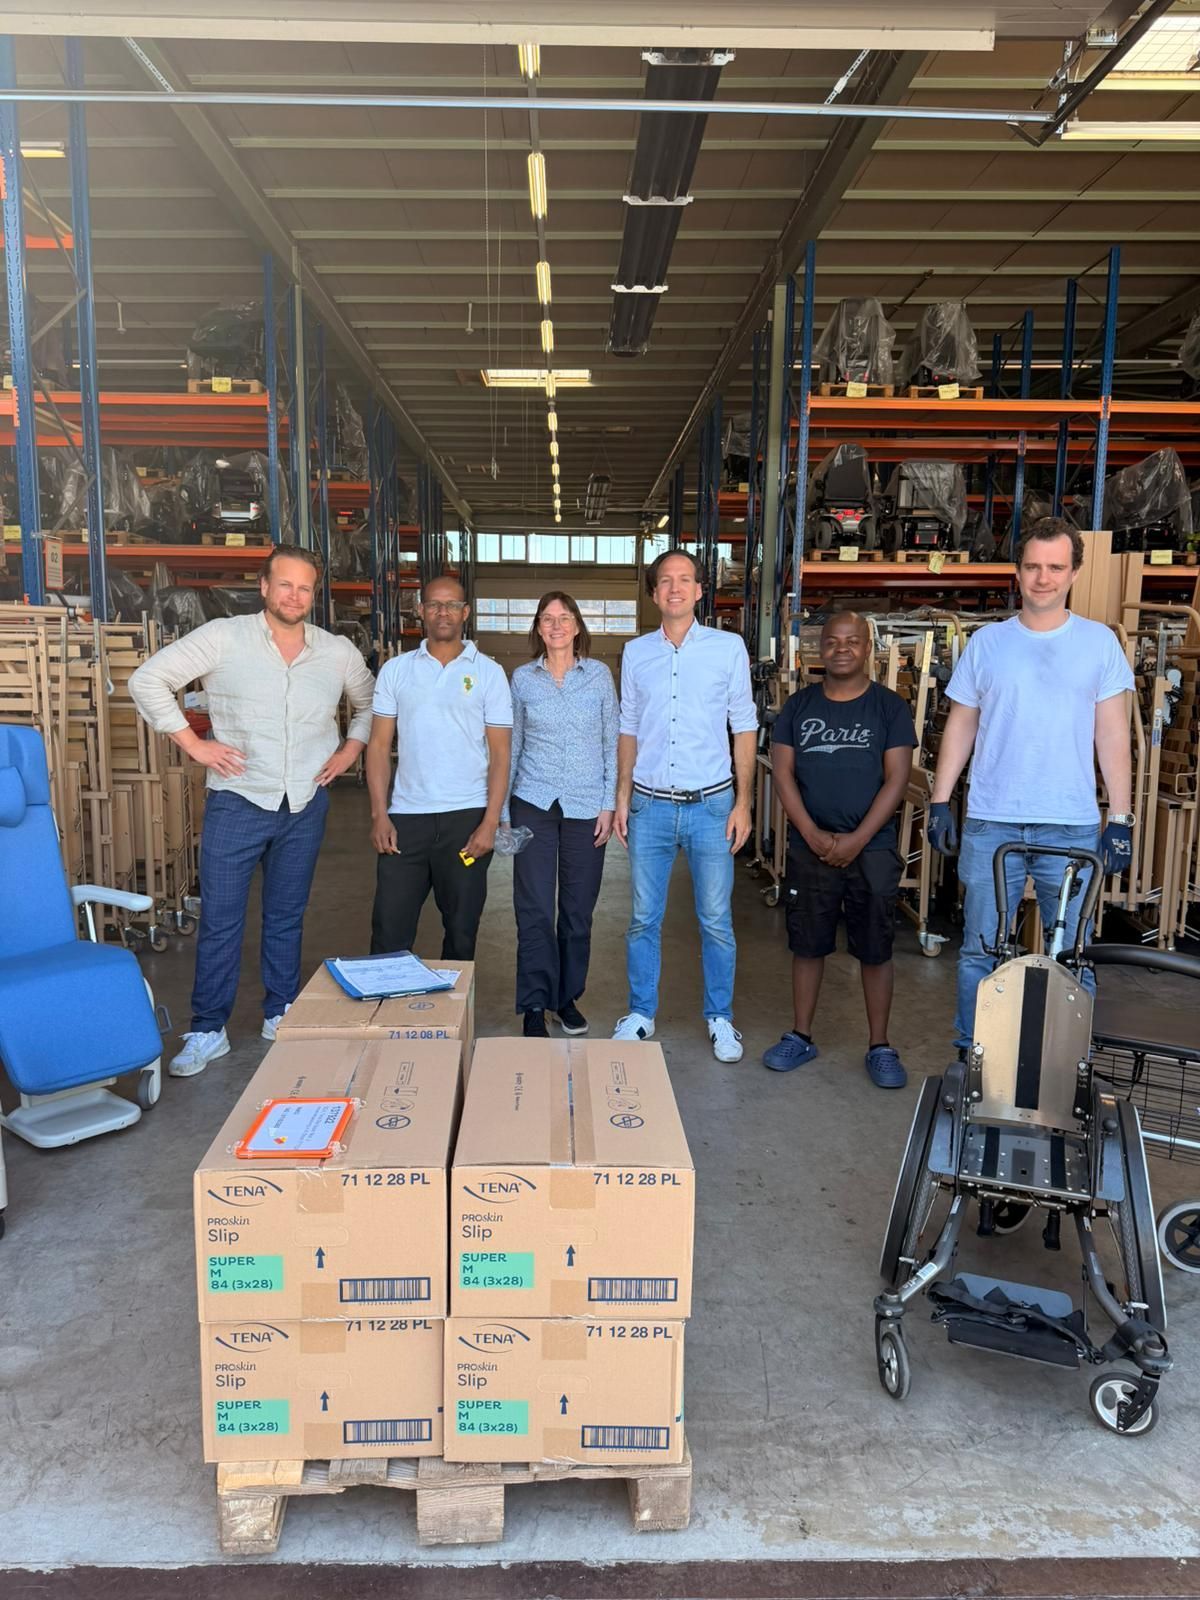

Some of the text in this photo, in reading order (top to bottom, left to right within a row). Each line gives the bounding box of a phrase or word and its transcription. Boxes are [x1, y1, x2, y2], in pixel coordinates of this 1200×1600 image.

[800, 718, 873, 746] Paris
[388, 1030, 450, 1039] 71 12 08 PL
[341, 1173, 430, 1186] 71 12 28 PL
[594, 1173, 681, 1185] 71 12 28 PL
[222, 1185, 266, 1197] TENA
[479, 1182, 521, 1193] TENA
[208, 1216, 249, 1226] PROskin
[462, 1212, 503, 1222] PROskin
[209, 1229, 239, 1245] Slip
[462, 1225, 492, 1241] Slip
[210, 1257, 255, 1266] SUPER
[462, 1253, 507, 1262] SUPER
[210, 1269, 222, 1278] M
[463, 1265, 473, 1273] M
[210, 1280, 272, 1290] 84 (3x28)
[463, 1276, 523, 1287] 84 (3x28)
[345, 1320, 432, 1331] 71 12 28 PL
[586, 1326, 672, 1338] 71 12 28 PL
[231, 1333, 274, 1343] TENA
[473, 1333, 515, 1344] TENA
[215, 1361, 256, 1371] PROskin
[457, 1362, 498, 1371] PROskin
[216, 1374, 246, 1390] Slip
[458, 1374, 487, 1390] Slip
[217, 1401, 262, 1409] SUPER
[458, 1400, 502, 1409] SUPER
[218, 1412, 228, 1421] M
[459, 1412, 469, 1420] M
[219, 1422, 278, 1433] 84 (3x28)
[459, 1423, 517, 1433] 84 (3x28)
